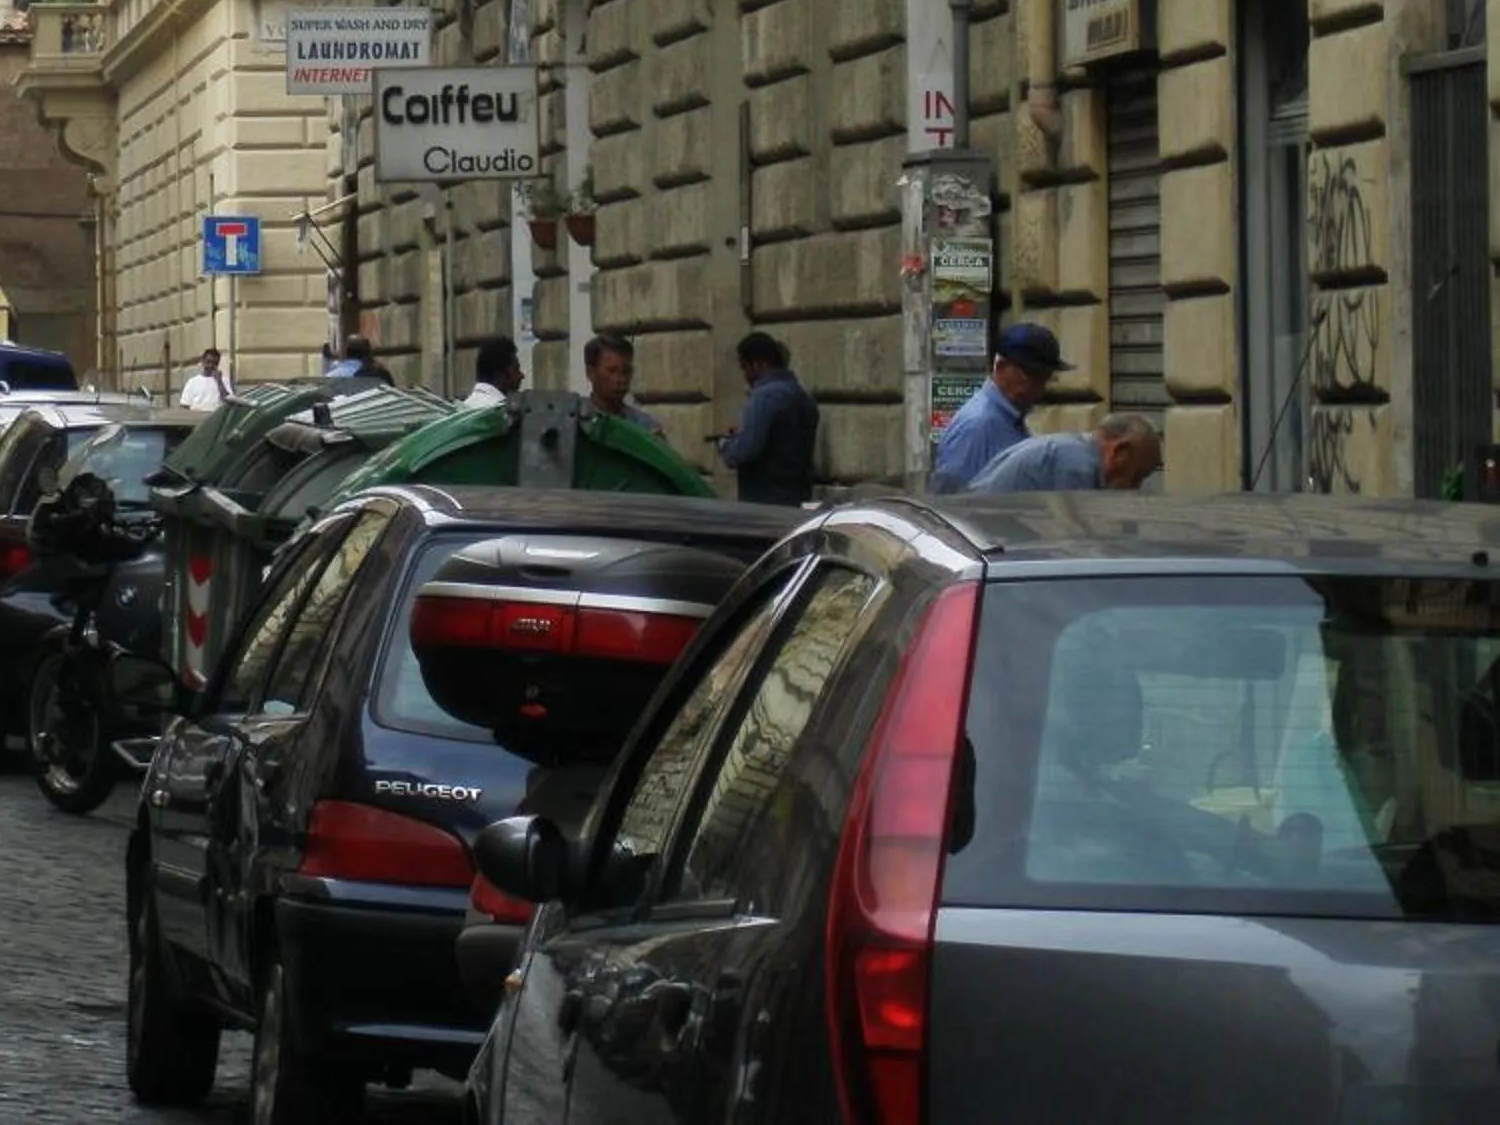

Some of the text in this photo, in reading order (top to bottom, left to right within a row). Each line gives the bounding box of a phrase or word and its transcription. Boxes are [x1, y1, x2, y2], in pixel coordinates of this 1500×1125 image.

[291, 19, 333, 31] SUPER
[334, 18, 369, 31] WASH
[372, 18, 400, 31] AND
[402, 18, 428, 31] DRY
[297, 42, 421, 60] LAUNDROMAT
[293, 68, 371, 83] INTERNET
[422, 146, 534, 174] Claudio
[375, 779, 482, 802] PEUGEOT
